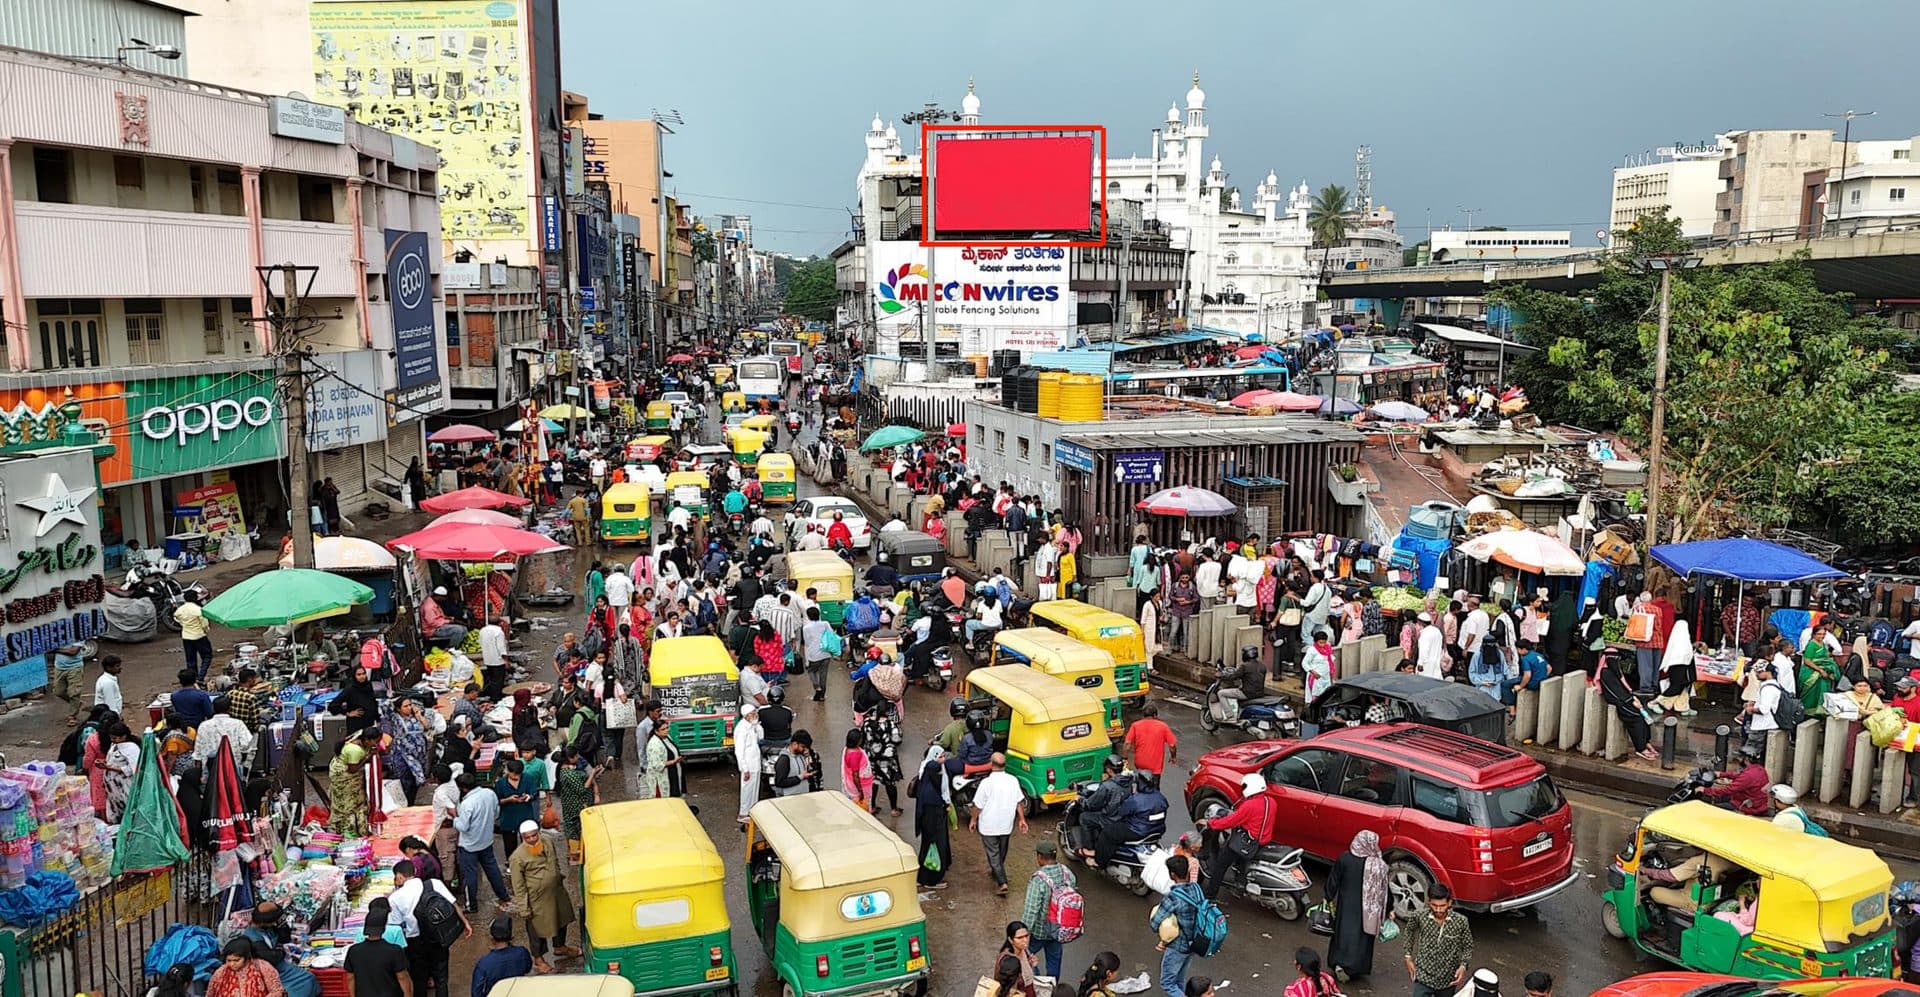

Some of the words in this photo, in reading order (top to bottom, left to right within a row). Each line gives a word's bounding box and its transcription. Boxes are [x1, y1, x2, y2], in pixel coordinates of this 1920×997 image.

[1675, 140, 1724, 155] Rainbow
[546, 204, 556, 250] BEARINGS
[922, 304, 957, 314] Drable
[961, 305, 995, 316] Fencing
[999, 304, 1040, 314] Solutions
[307, 408, 335, 425] NDRA
[337, 403, 374, 421] BHAVAN
[9, 618, 75, 662] SHAHEED
[660, 686, 691, 697] THREE
[660, 697, 689, 707] RIDES
[660, 707, 684, 716] FREE
